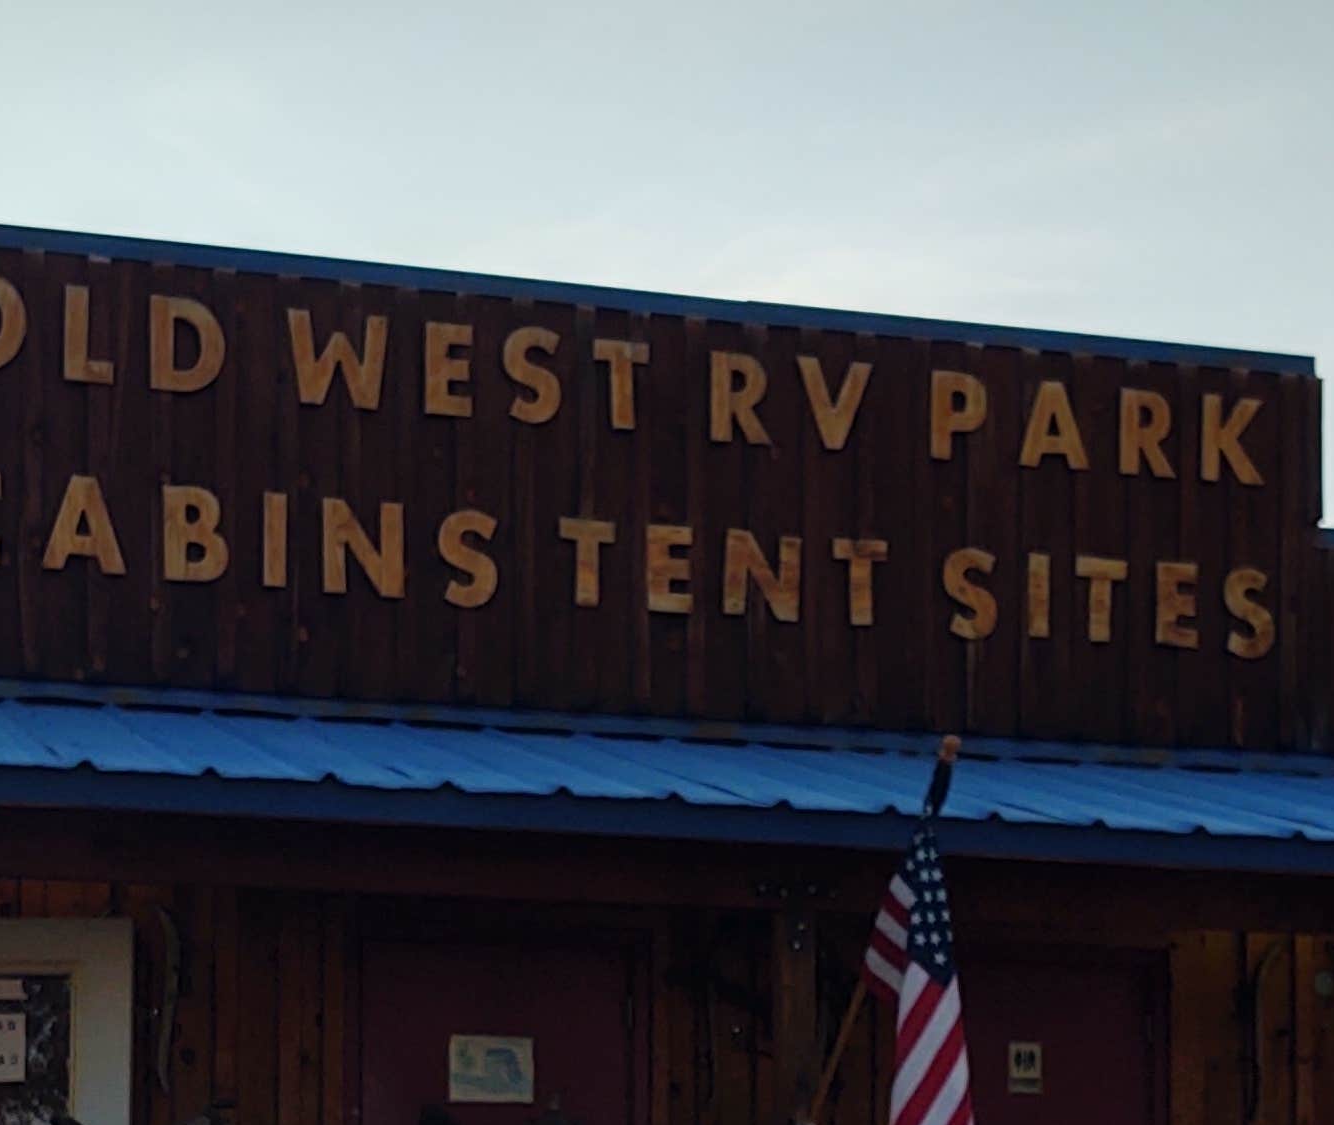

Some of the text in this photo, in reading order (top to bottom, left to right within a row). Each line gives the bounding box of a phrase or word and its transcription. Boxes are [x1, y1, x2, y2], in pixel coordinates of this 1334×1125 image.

[286, 307, 649, 431] WEST
[709, 349, 872, 451] RV
[929, 369, 1266, 487] PARK
[558, 516, 888, 627] TENT
[940, 547, 1277, 660] SITES
